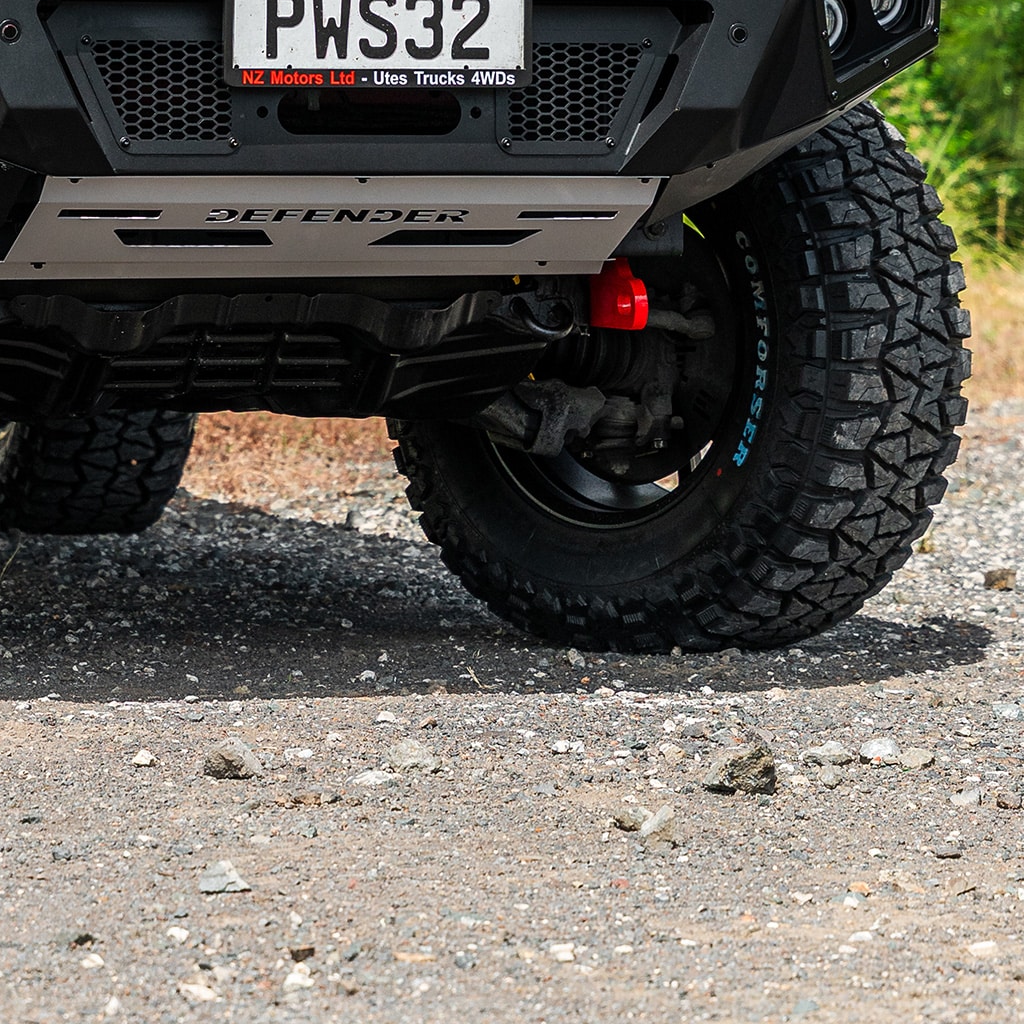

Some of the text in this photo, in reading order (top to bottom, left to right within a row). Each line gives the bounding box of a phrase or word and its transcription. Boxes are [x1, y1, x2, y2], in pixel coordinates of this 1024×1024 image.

[242, 70, 264, 85] NZ
[270, 70, 324, 85] Motors
[329, 70, 355, 85] Ltd
[373, 70, 408, 85] Utes
[414, 70, 466, 85] Trucks
[471, 70, 516, 86] 4WDs
[205, 208, 470, 224] DEFENDER
[733, 230, 769, 467] COMFORSER
